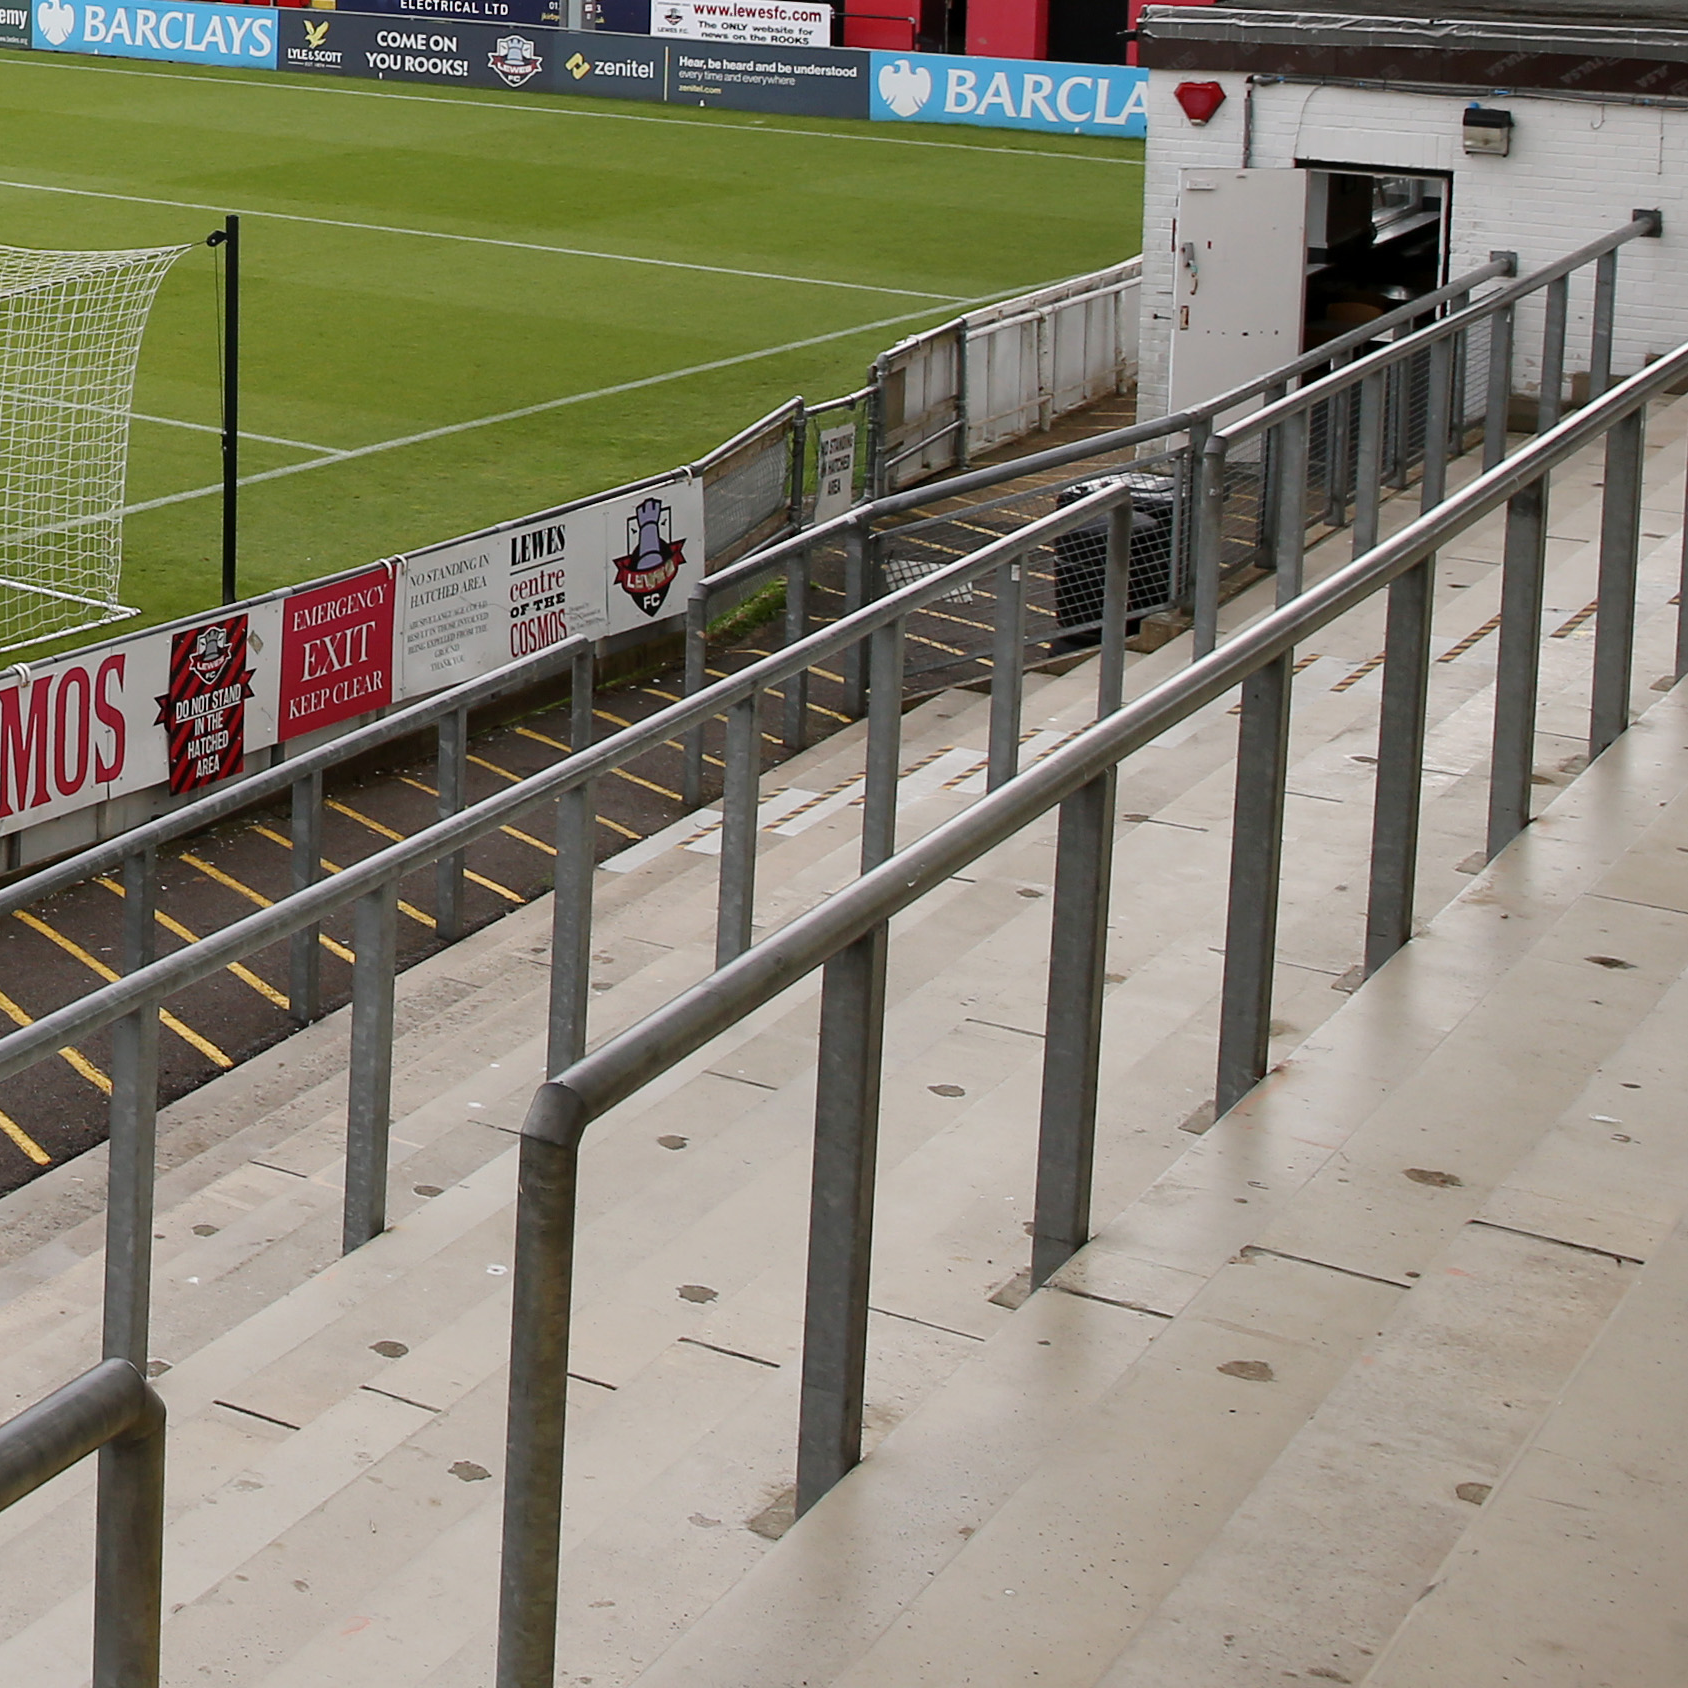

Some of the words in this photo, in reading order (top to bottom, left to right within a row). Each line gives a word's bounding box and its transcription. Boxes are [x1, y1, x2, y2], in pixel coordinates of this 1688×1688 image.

[485, 2, 509, 16] LTD
[693, 3, 822, 23] www.lewesfc.com
[83, 4, 272, 58] BARCLAYS
[698, 20, 717, 29] The
[721, 21, 748, 31] ONLY
[752, 24, 794, 35] website
[799, 27, 813, 36] for
[701, 31, 729, 40] news
[750, 34, 767, 42] the
[771, 35, 810, 45] ROOKS
[377, 30, 427, 51] COME
[429, 35, 457, 53] ON
[365, 52, 402, 71] YOU
[405, 58, 469, 77] ROOKS!
[497, 62, 533, 74] LEWES
[595, 61, 654, 79] zenitel
[679, 55, 707, 70] Hear,
[708, 58, 721, 69] be
[723, 60, 754, 71] heard
[755, 62, 776, 73] and
[777, 63, 791, 74] be
[793, 64, 858, 78] understood
[507, 75, 521, 83] FC
[679, 70, 703, 81] every
[704, 71, 723, 81] time
[724, 73, 741, 83] and
[743, 74, 796, 86] everywhere
[511, 524, 565, 567] LEWES
[409, 573, 425, 588] NO
[427, 557, 477, 582] STANDING
[479, 553, 490, 569] IN
[410, 583, 459, 609] HATCHED
[460, 575, 487, 593] AREA
[510, 569, 565, 602] centre
[293, 584, 387, 632] EMERGENCY
[510, 602, 530, 618] OF
[533, 592, 565, 612] THE
[643, 593, 661, 610] FC
[510, 608, 567, 658] COSMOS
[301, 621, 376, 682] EXIT
[205, 671, 216, 679] FC
[176, 700, 189, 719] DO
[191, 692, 211, 715] NOT
[212, 683, 242, 709] STAND
[289, 687, 329, 720] KEEP
[333, 670, 383, 704] CLEAR
[194, 718, 205, 736] IN
[207, 710, 223, 732] THE
[187, 730, 229, 760] HATCHED
[196, 754, 220, 779] AREA
